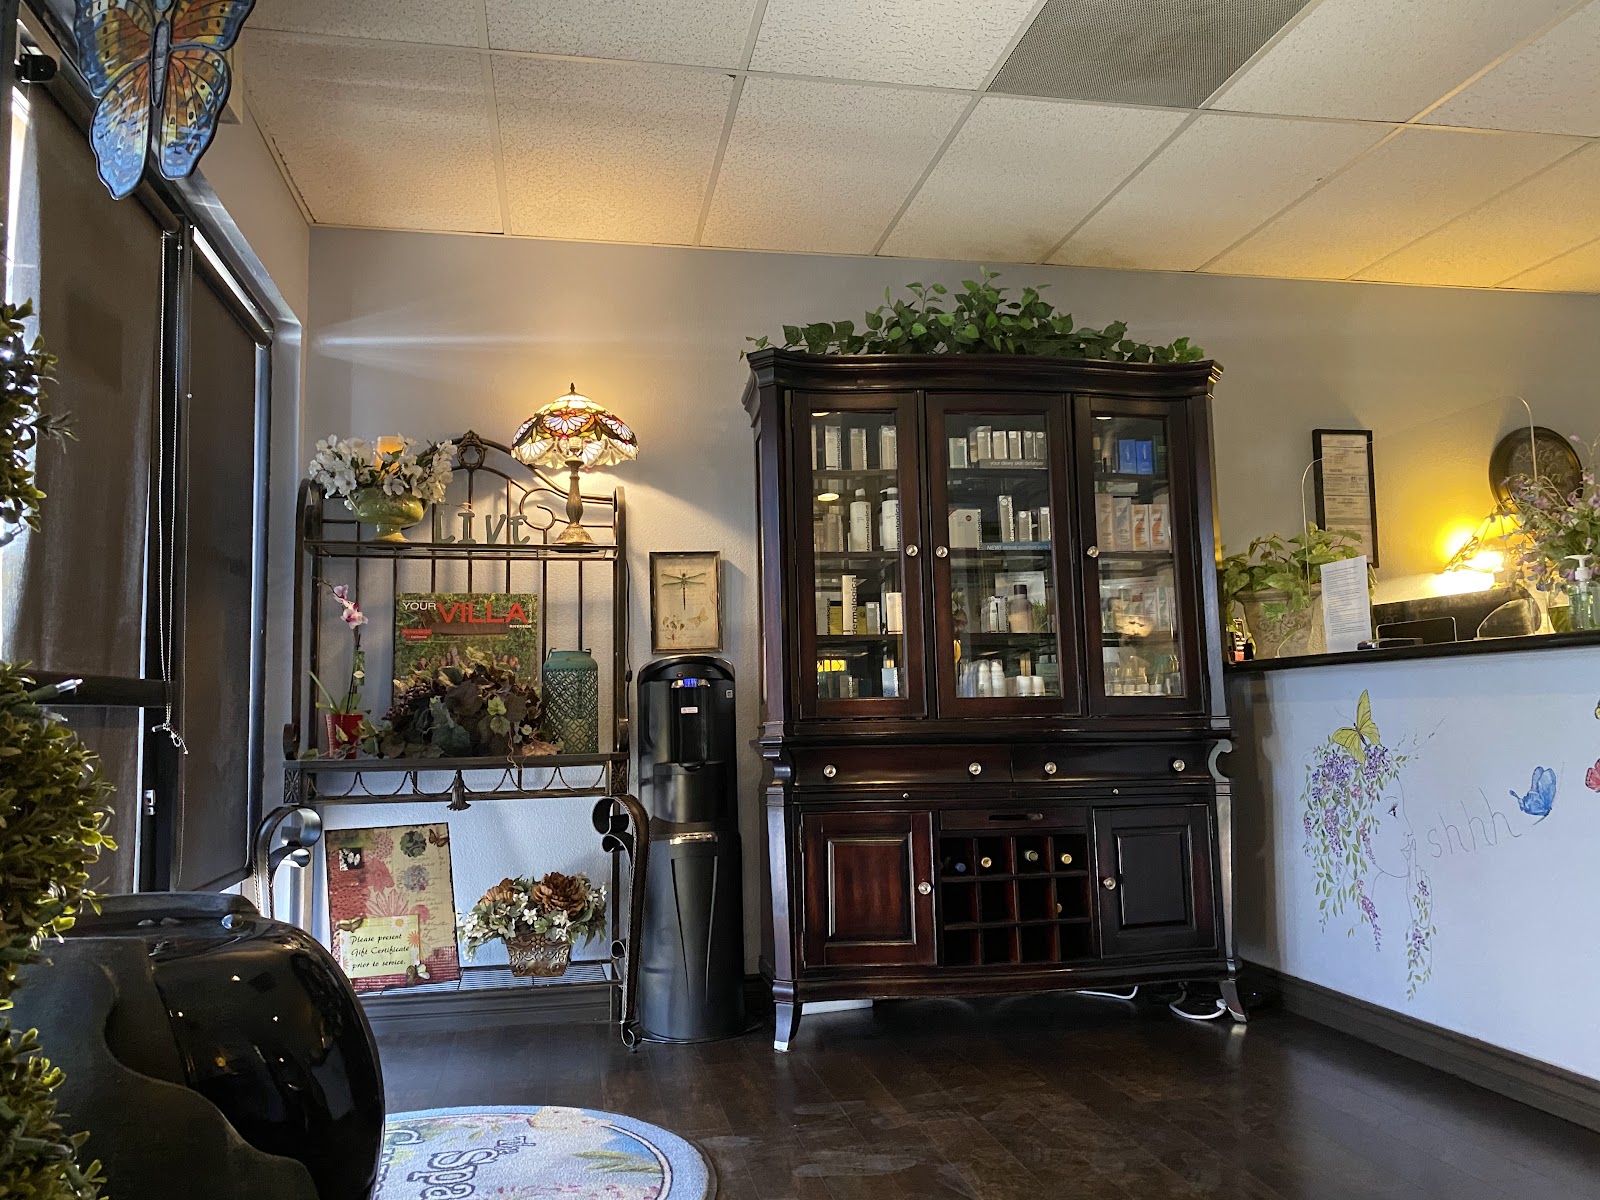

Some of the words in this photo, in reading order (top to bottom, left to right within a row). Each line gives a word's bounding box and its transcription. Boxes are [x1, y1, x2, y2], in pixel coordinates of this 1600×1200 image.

[402, 602, 437, 611] YOUR
[436, 601, 529, 624] VILLA
[1427, 787, 1523, 858] shhh
[350, 935, 375, 945] Please
[377, 933, 402, 944] present
[351, 947, 368, 957] Gift
[370, 944, 410, 955] Certificate
[352, 962, 370, 972] prior
